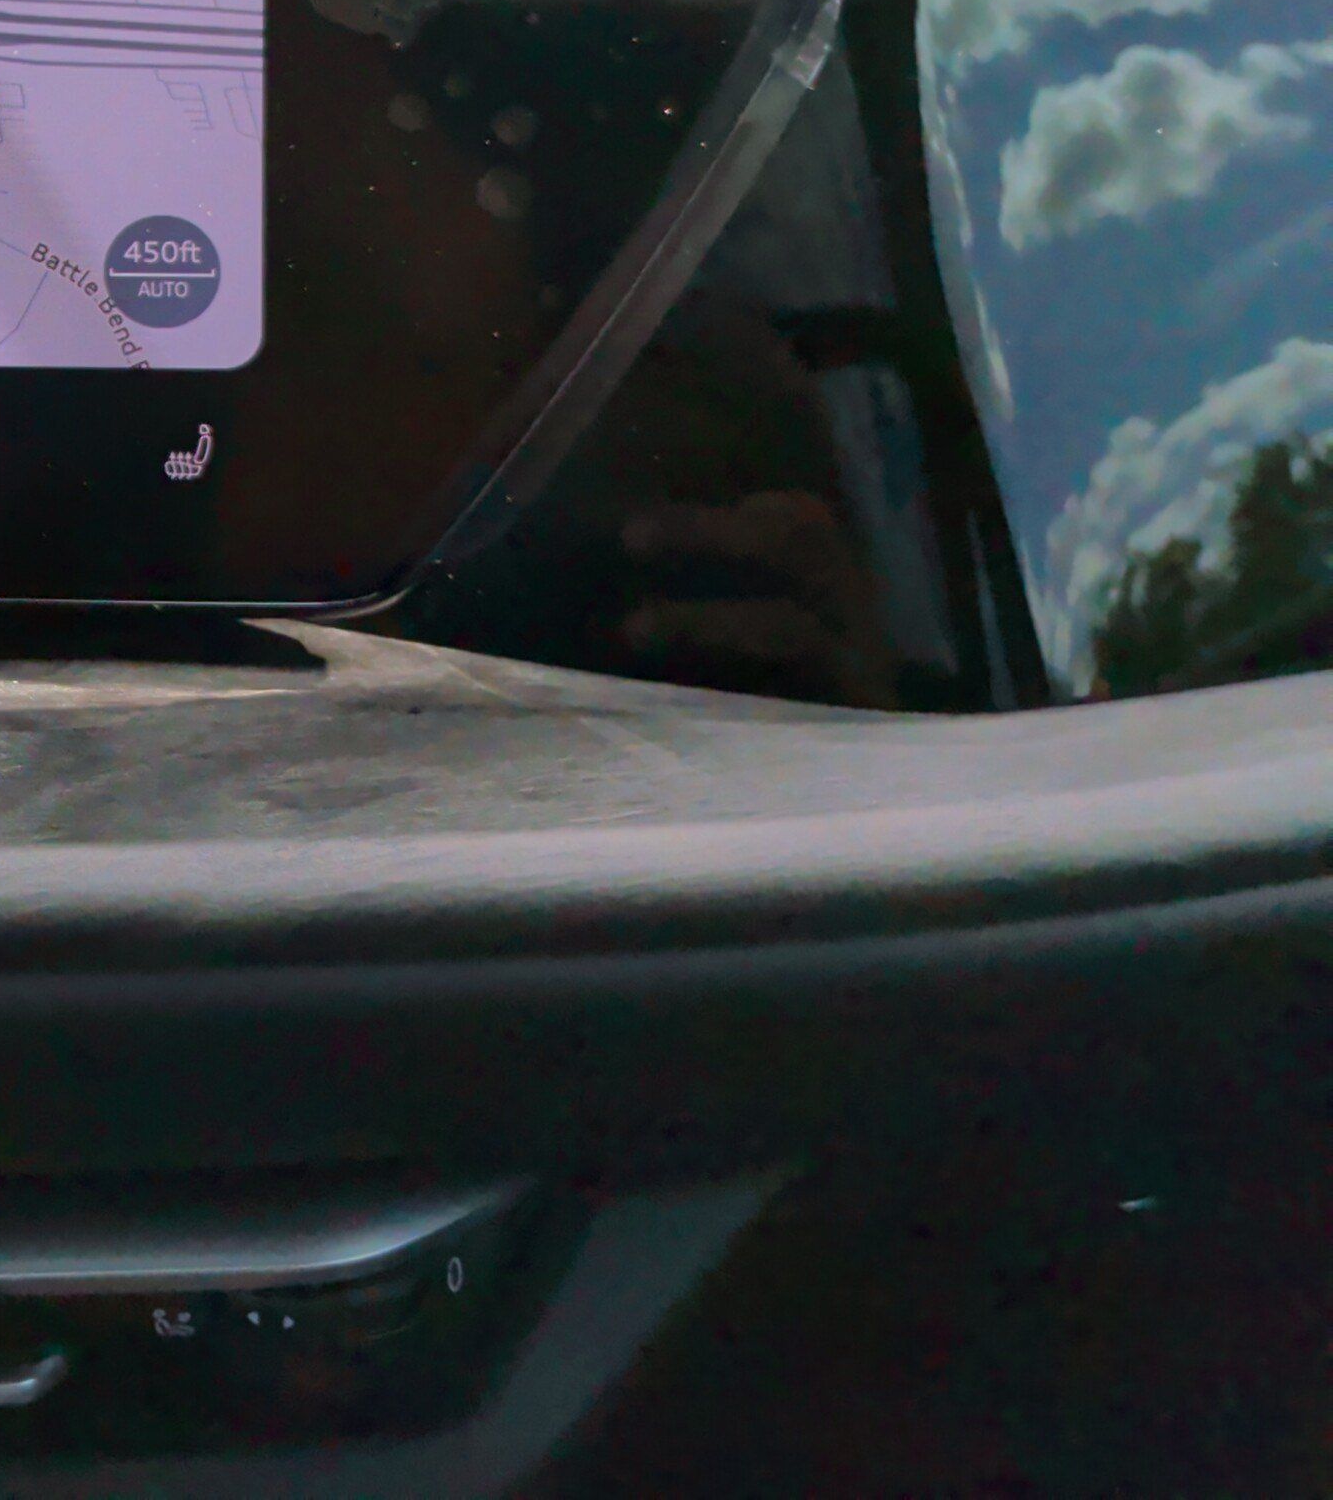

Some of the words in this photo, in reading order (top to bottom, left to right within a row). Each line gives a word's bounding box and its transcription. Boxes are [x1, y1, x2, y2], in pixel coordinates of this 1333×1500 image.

[123, 240, 202, 263] 450ft
[31, 243, 99, 296] Battle
[98, 297, 143, 356] Bend
[137, 281, 188, 297] AUTO
